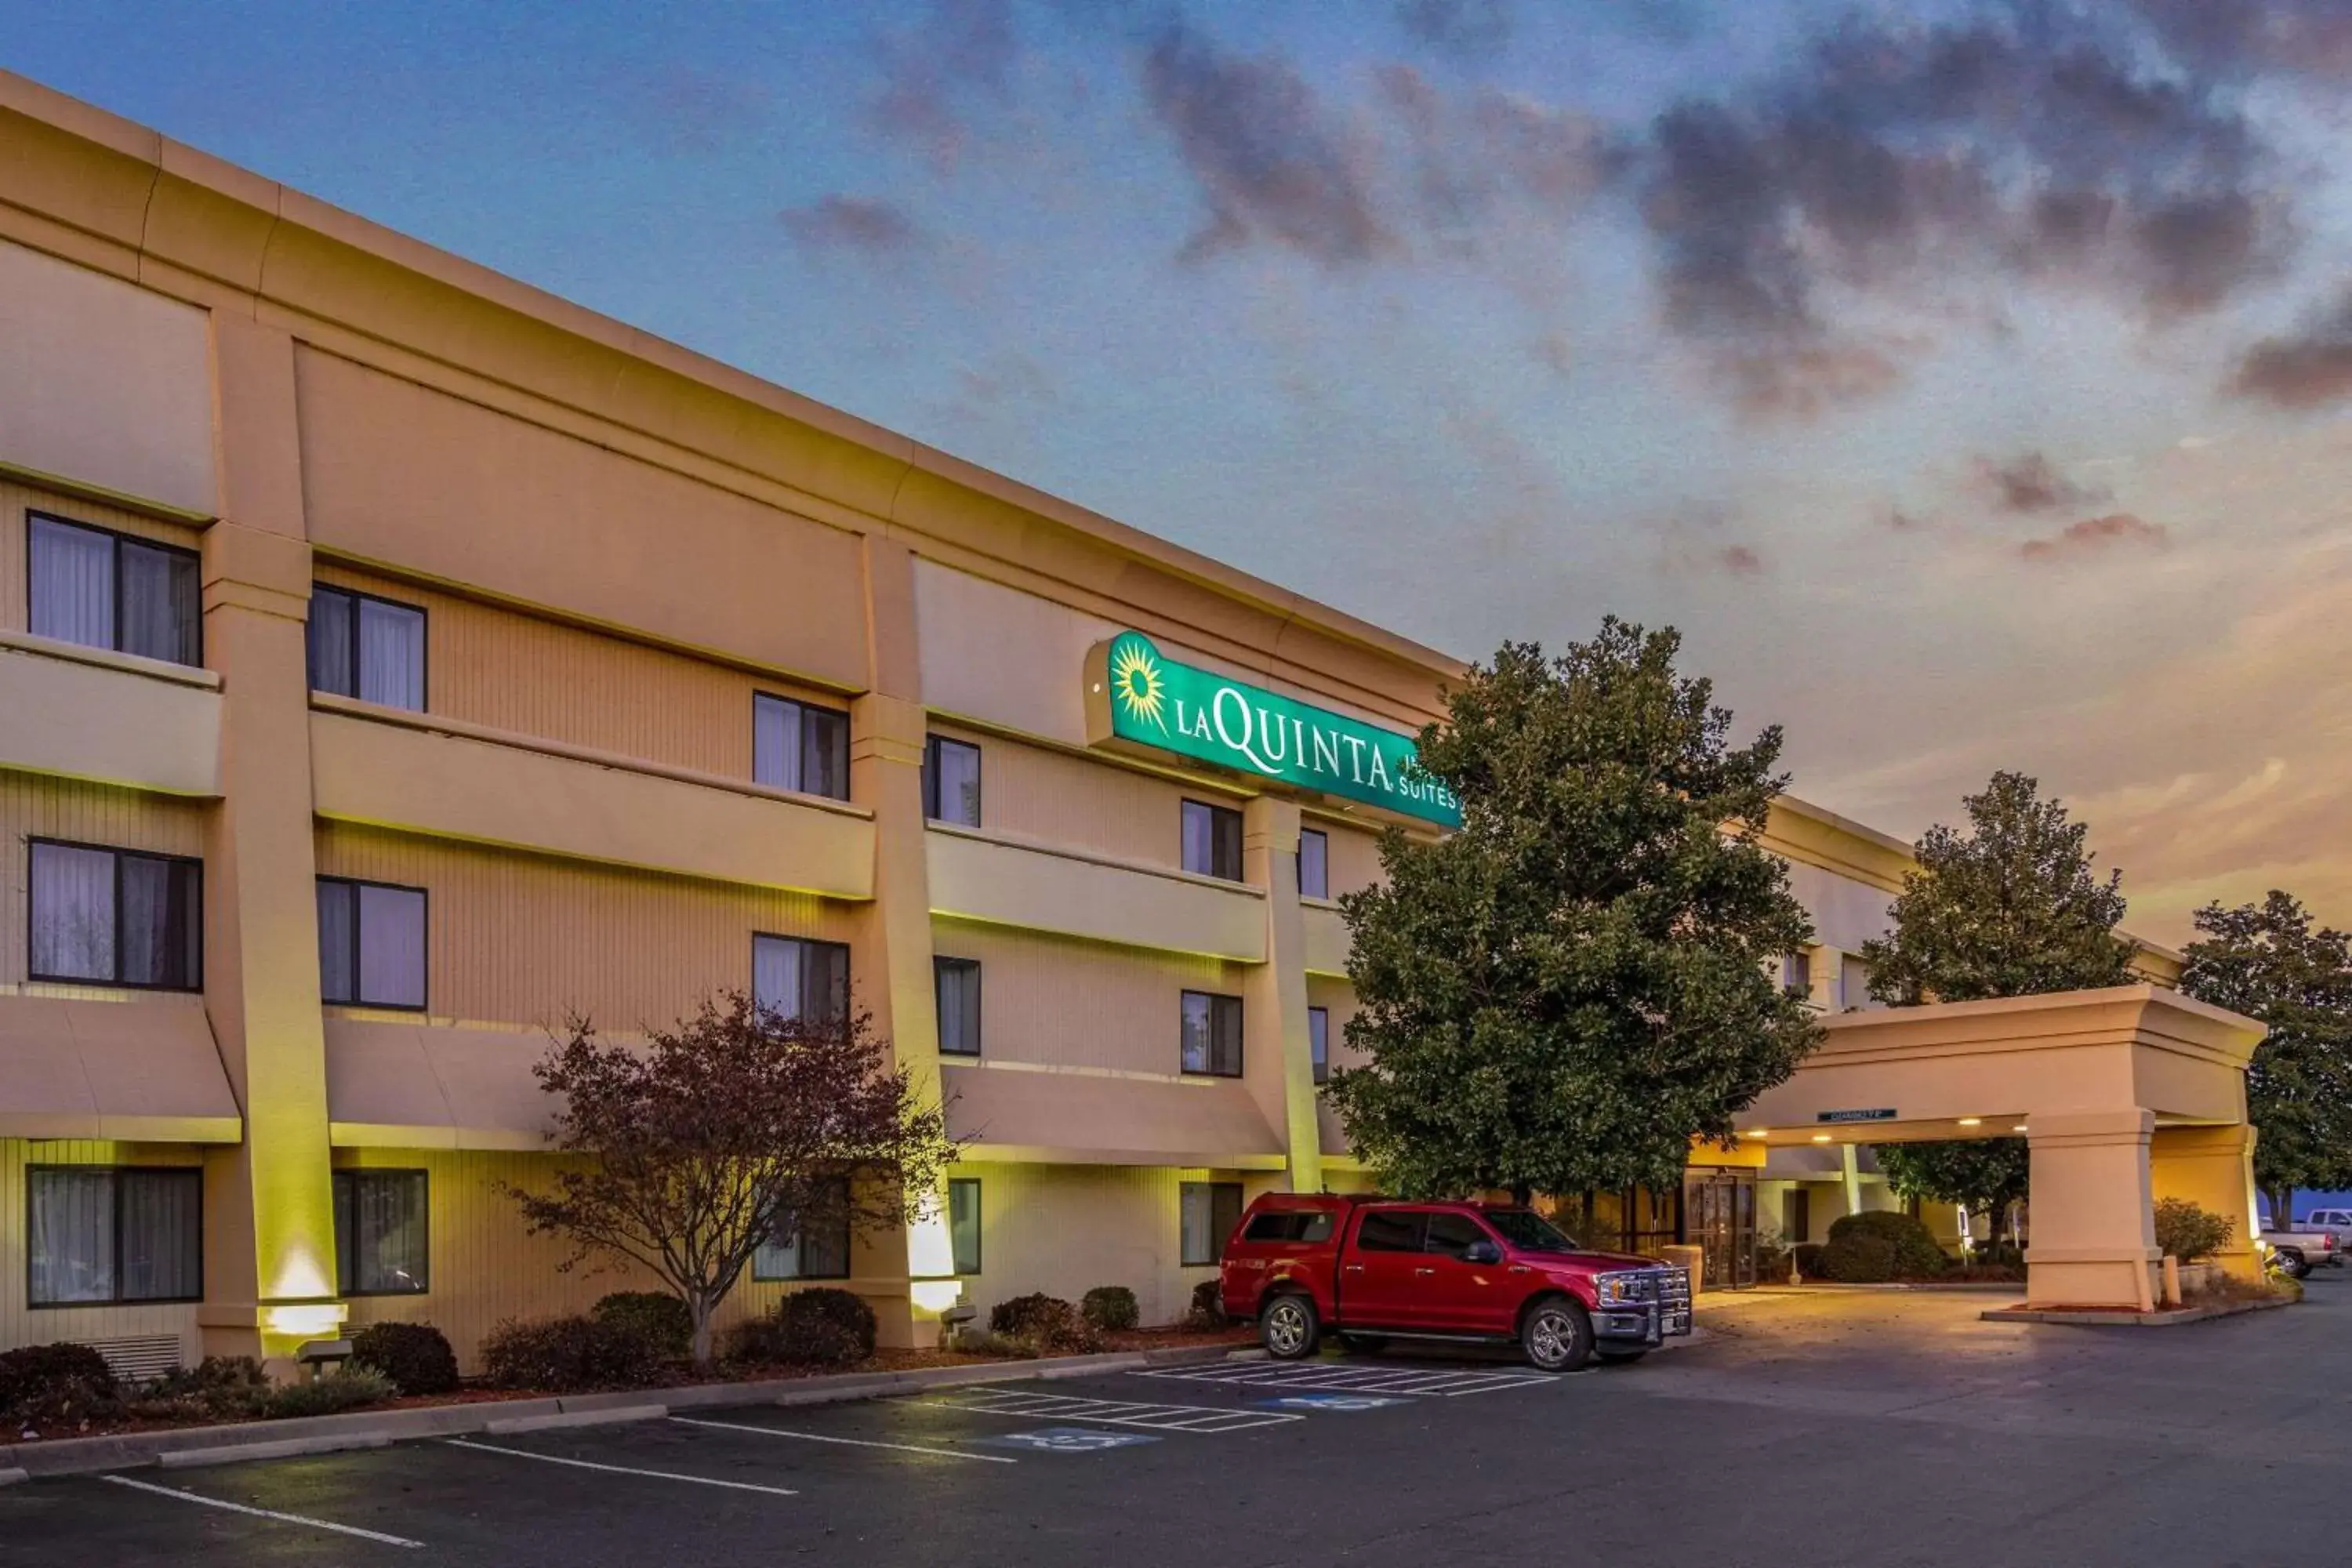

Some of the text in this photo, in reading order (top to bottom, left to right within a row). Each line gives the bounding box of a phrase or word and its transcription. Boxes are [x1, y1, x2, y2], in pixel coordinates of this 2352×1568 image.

[1175, 699, 1213, 741] LA
[1212, 687, 1392, 792] QUINTA
[1399, 775, 1456, 809] SUITES
